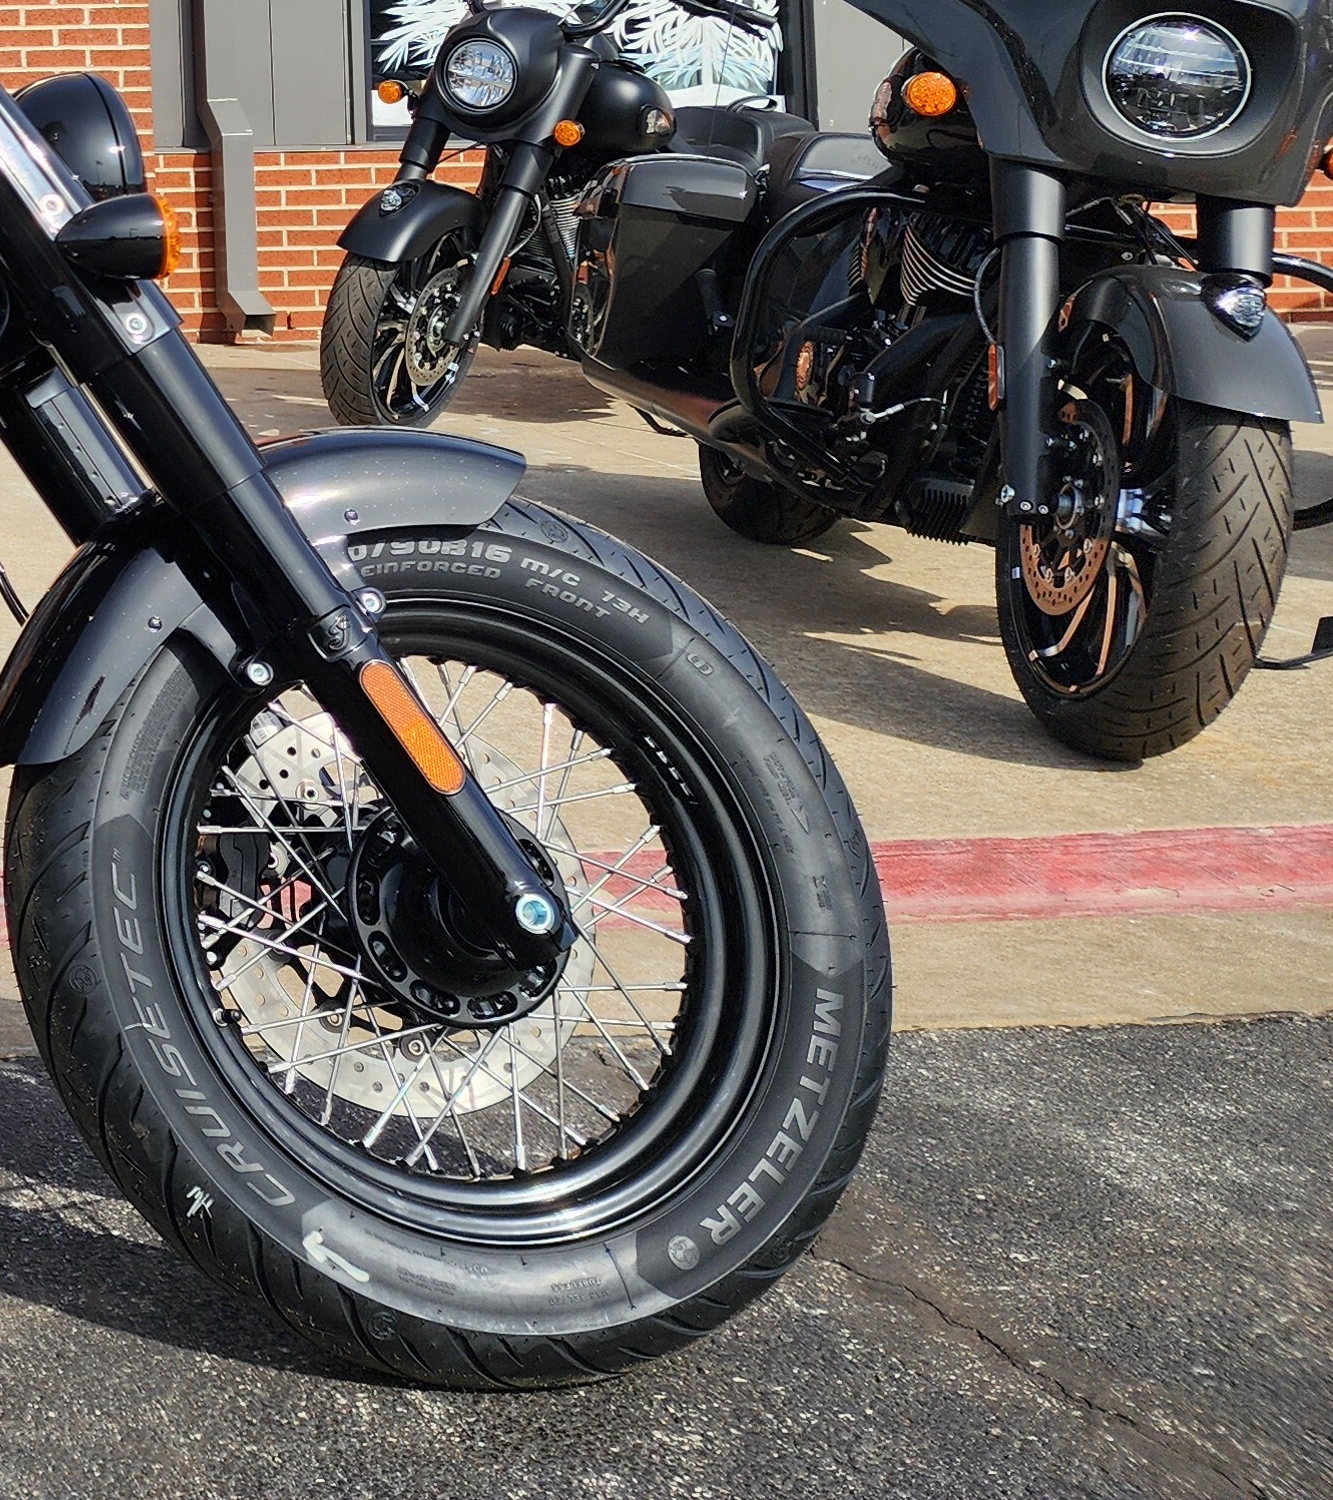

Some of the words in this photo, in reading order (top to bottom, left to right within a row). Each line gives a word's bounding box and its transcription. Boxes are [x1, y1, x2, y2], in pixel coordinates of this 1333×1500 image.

[360, 559, 502, 579] EINFORCED
[524, 577, 612, 619] FRONT
[600, 589, 651, 625] 73H
[111, 860, 296, 1207] CRUISETEC
[699, 987, 845, 1246] METZELER
